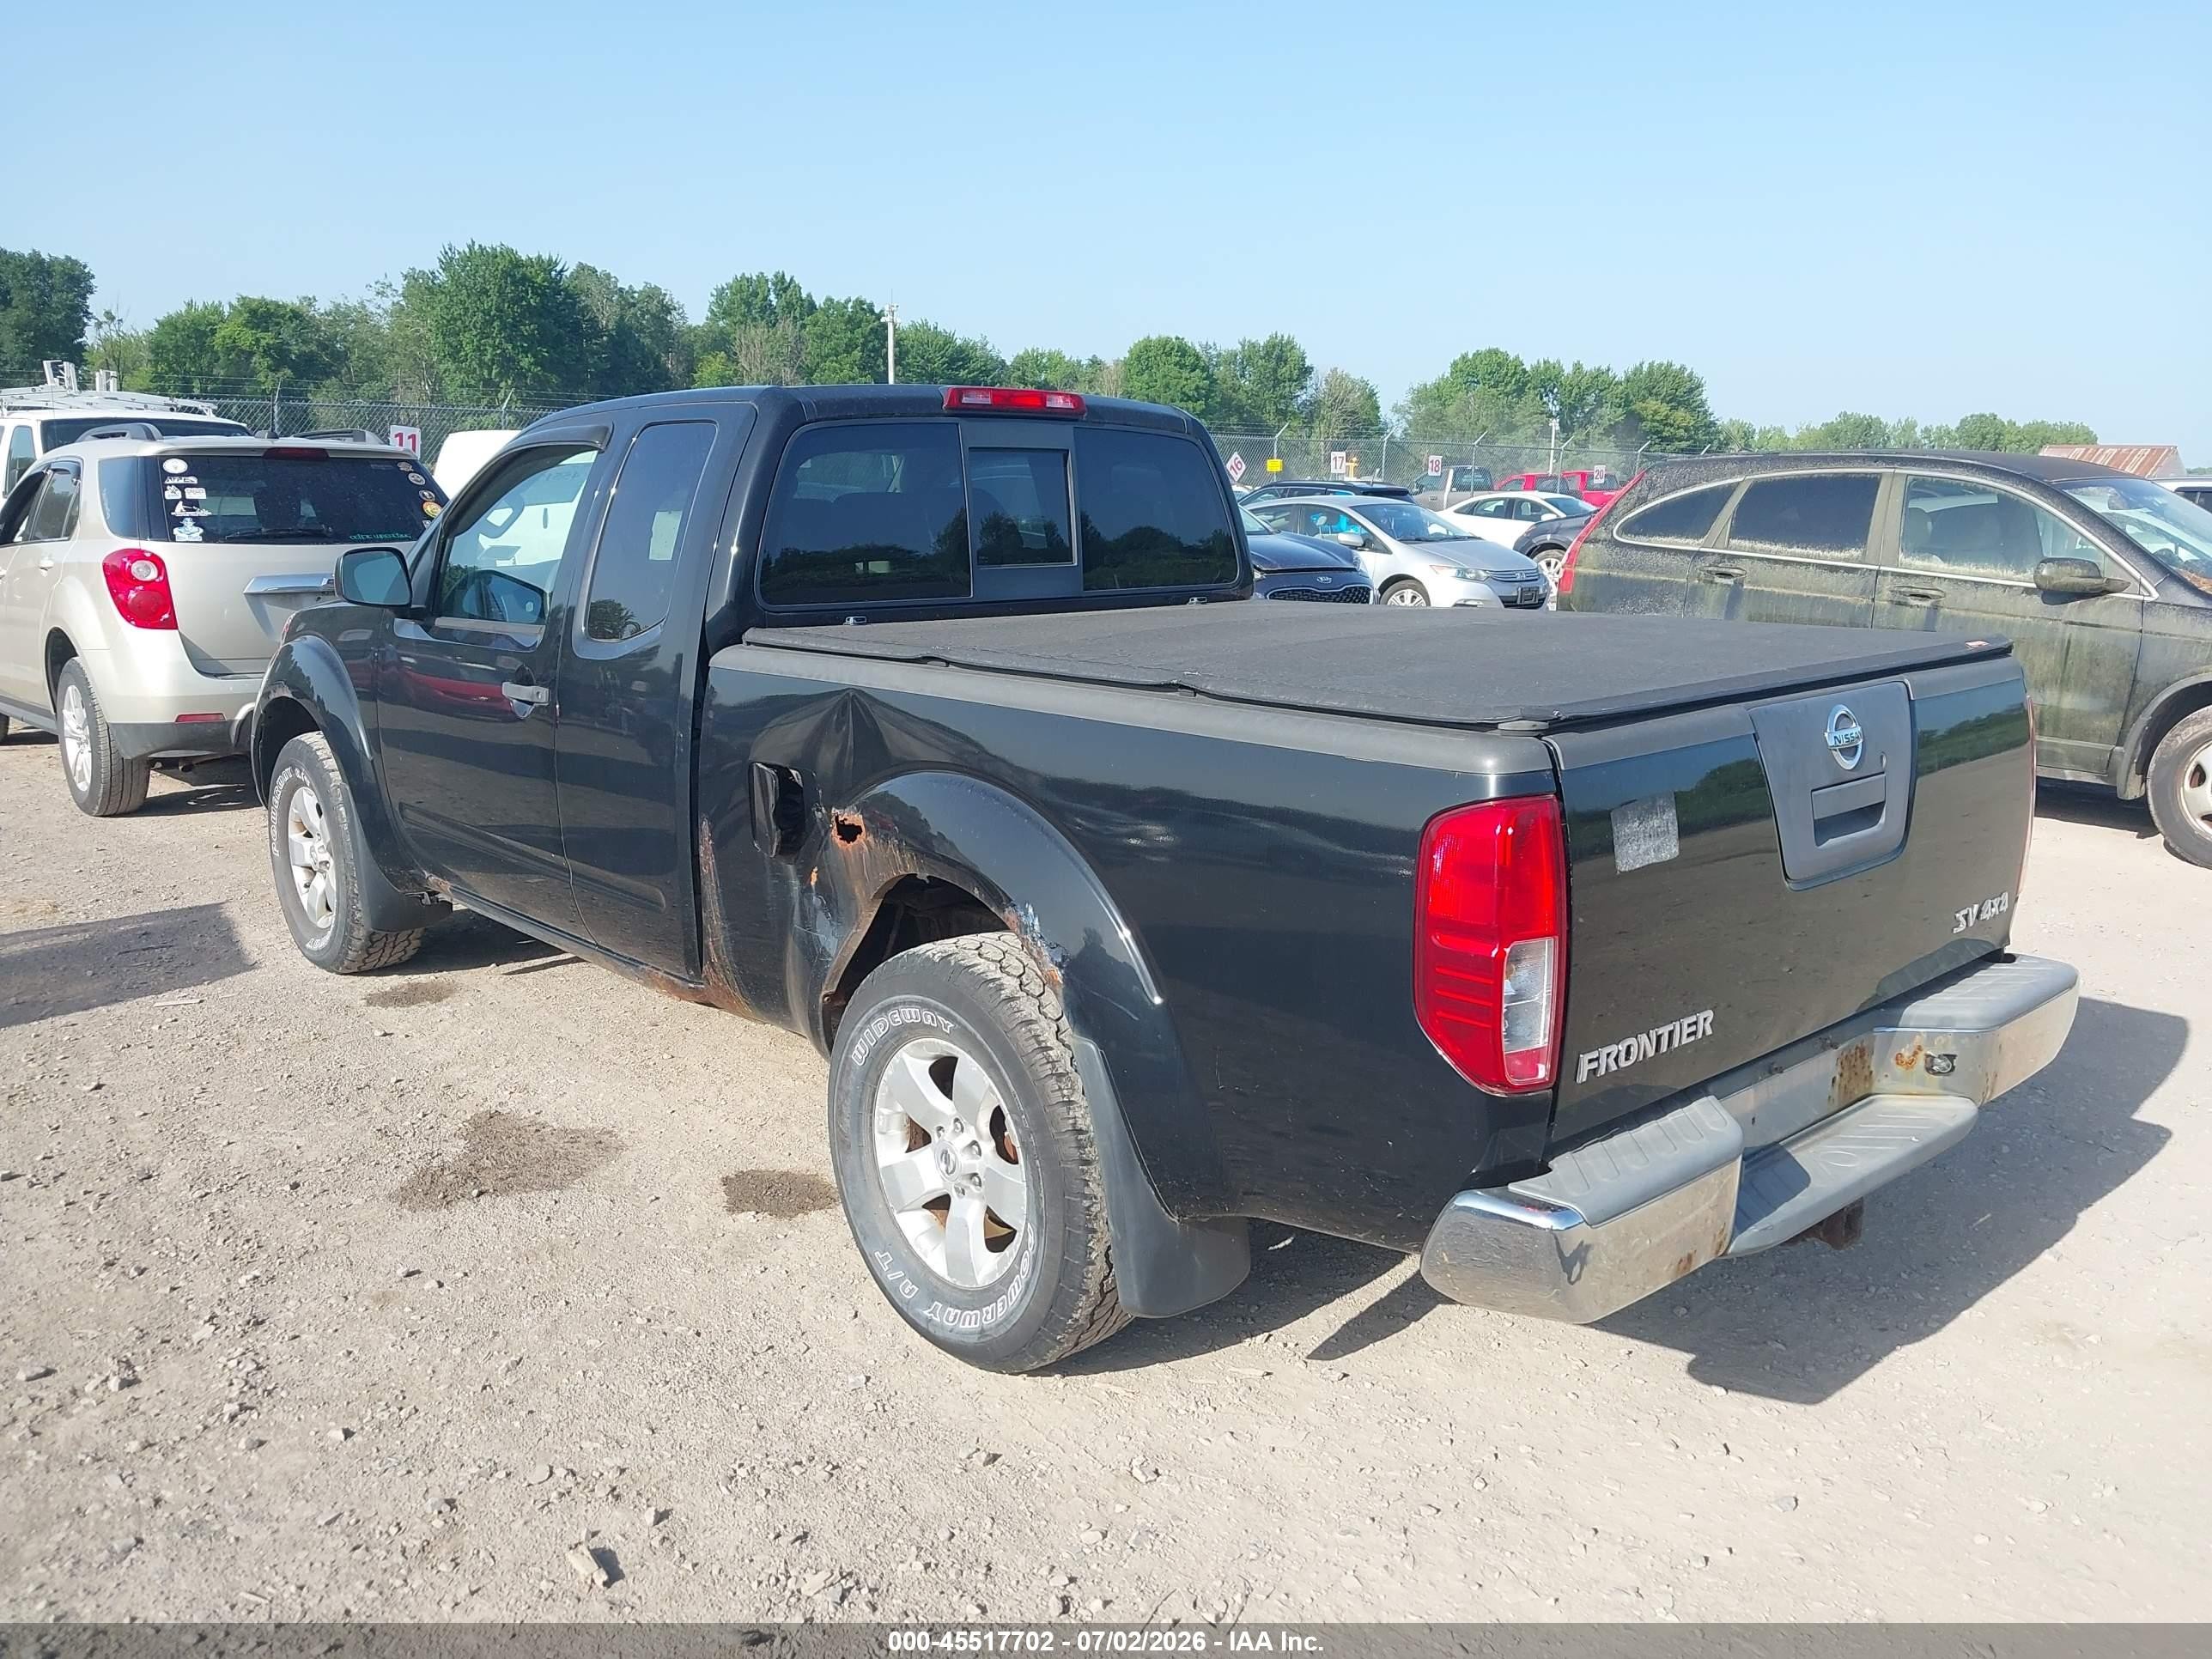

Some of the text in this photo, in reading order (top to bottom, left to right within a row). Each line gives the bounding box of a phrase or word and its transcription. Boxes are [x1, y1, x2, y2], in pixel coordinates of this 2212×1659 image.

[394, 432, 416, 454] 11
[1230, 457, 1243, 476] 16
[1332, 456, 1345, 470] 17
[1430, 459, 1441, 473] 18
[1595, 468, 1604, 480] 20
[1952, 903, 1979, 934] SV
[851, 1006, 956, 1066] WIDEWAY
[1576, 1009, 1714, 1084] FRONTIER
[874, 1223, 1035, 1328] POWERWAY A/T
